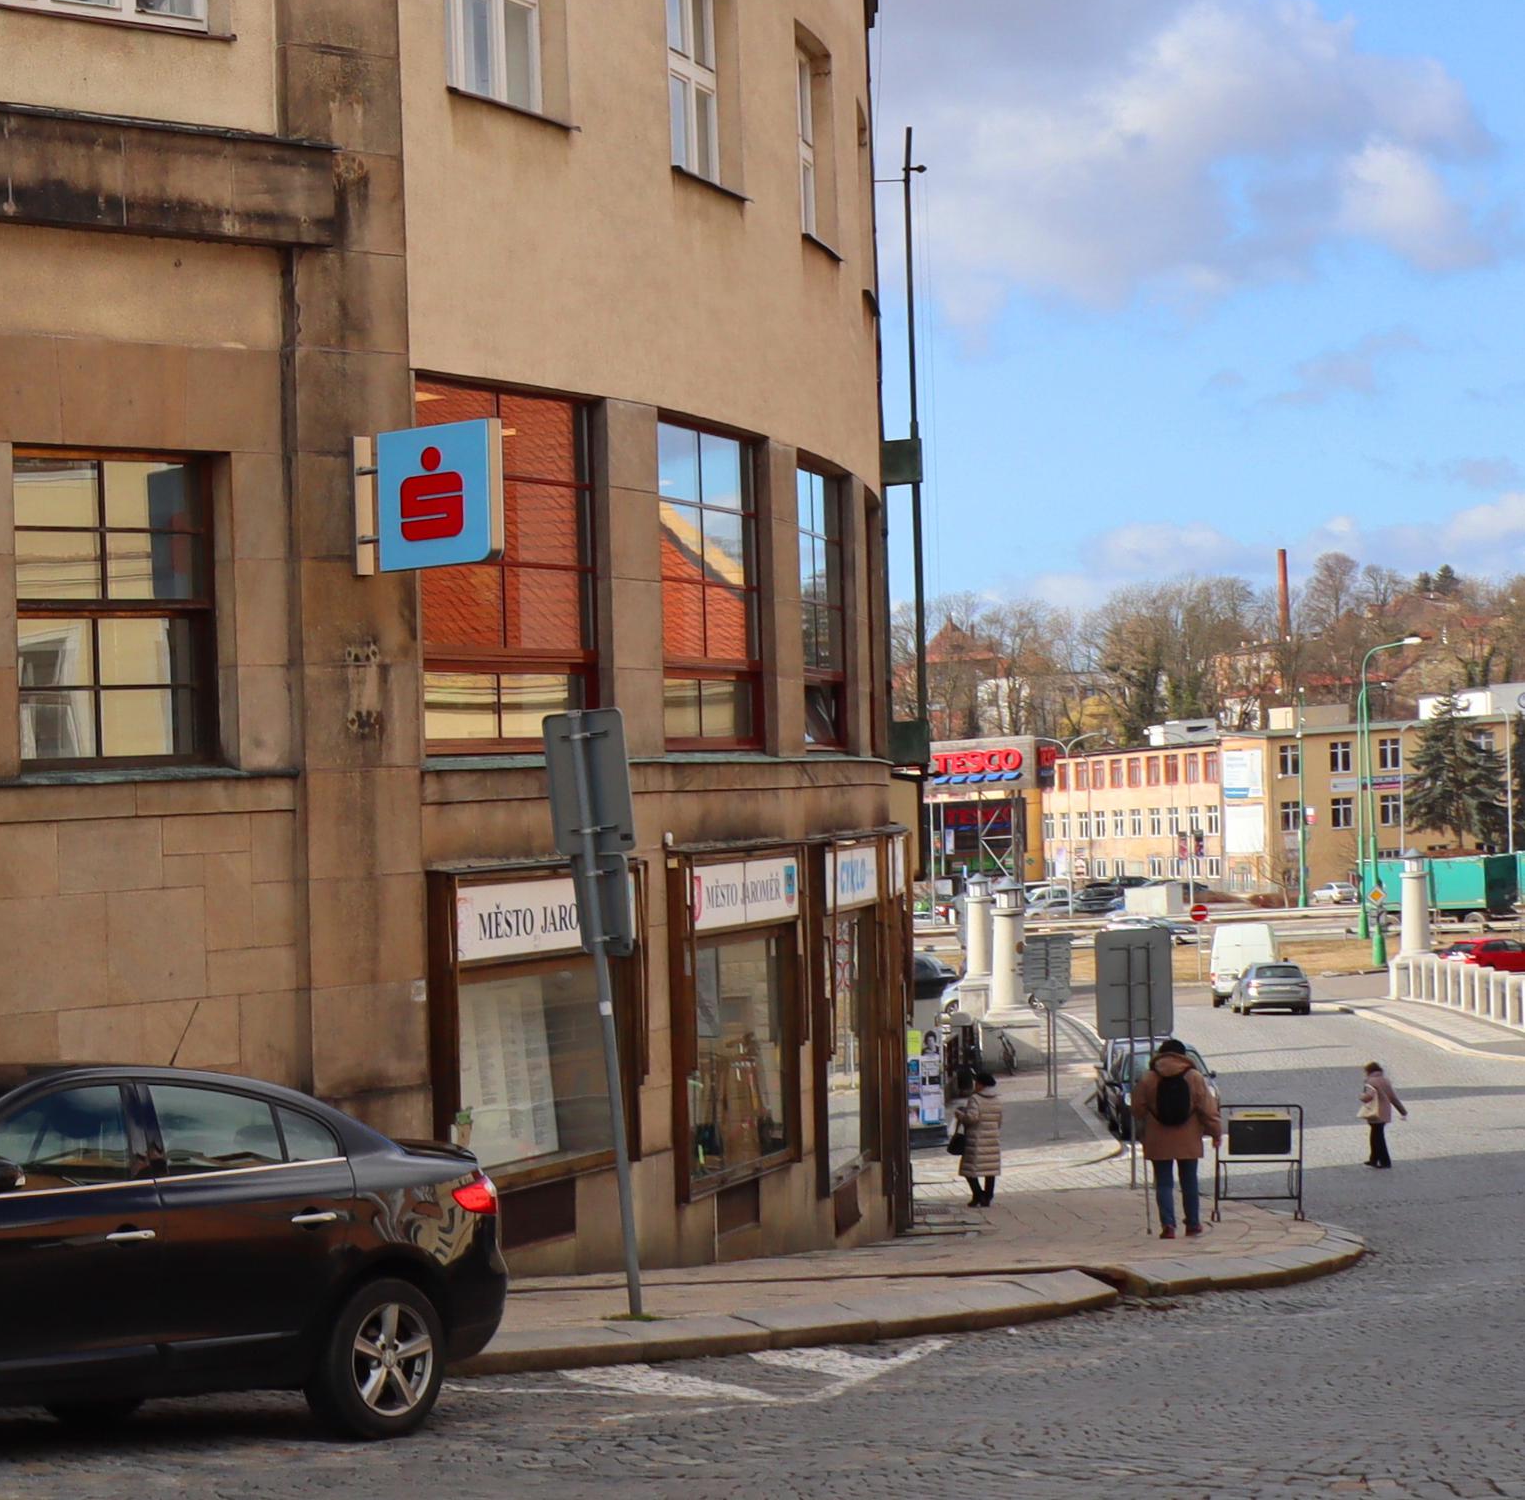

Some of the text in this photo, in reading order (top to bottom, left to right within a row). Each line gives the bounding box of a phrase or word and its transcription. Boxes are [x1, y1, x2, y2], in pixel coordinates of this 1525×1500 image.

[931, 748, 1023, 774] TESCO
[705, 872, 782, 909] MĚSTO JAROMĚŘ
[478, 902, 580, 940] MĚSTO JARO
